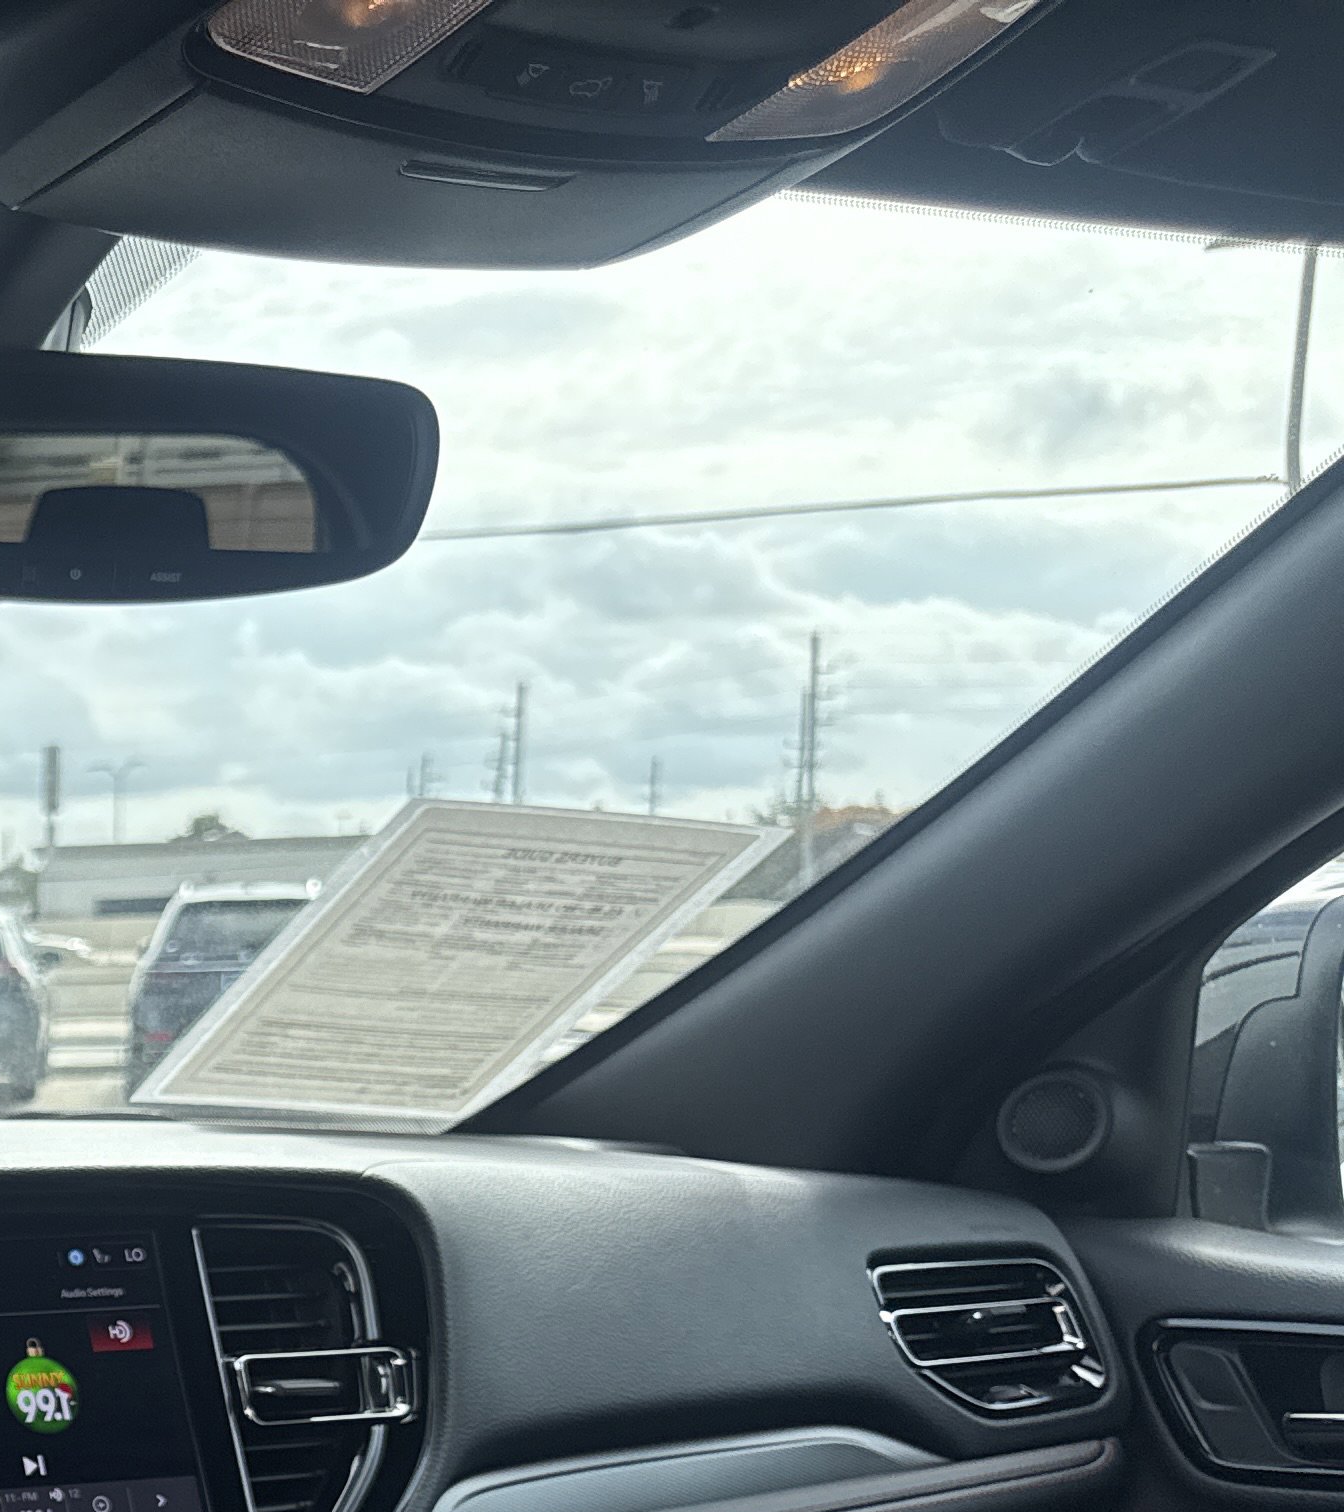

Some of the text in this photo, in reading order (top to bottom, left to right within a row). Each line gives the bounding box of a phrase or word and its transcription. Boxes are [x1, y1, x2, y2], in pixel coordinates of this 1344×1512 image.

[150, 572, 183, 583] ASSIST
[124, 1247, 147, 1262] LO
[61, 1286, 124, 1299] Audio Settings
[13, 1371, 65, 1391] SUNNY
[16, 1388, 73, 1423] 99.1
